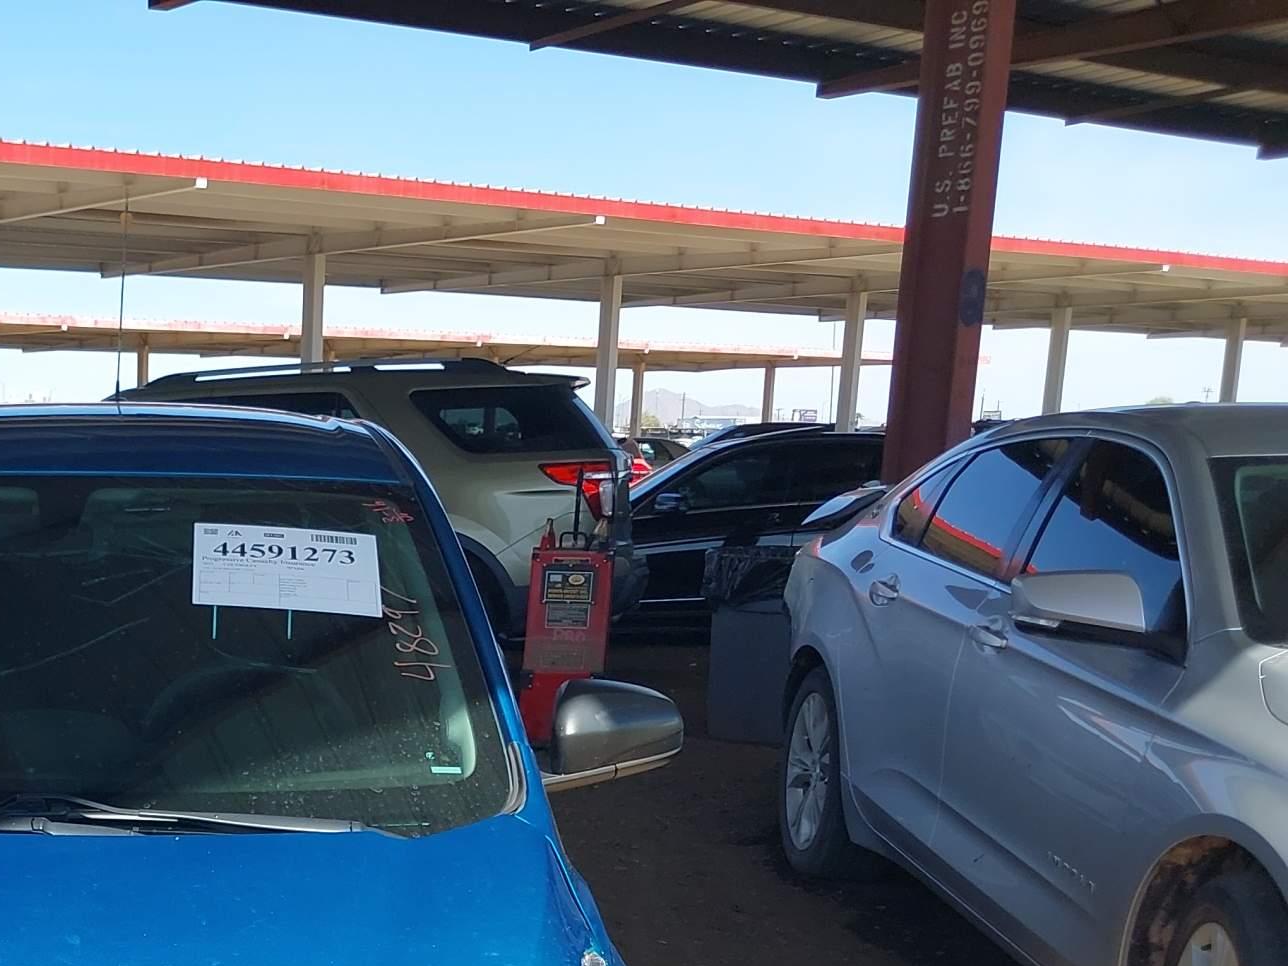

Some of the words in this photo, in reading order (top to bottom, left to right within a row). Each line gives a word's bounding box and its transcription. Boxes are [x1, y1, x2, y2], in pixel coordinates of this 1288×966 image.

[948, 10, 967, 49] INC
[938, 61, 963, 158] PREFAB
[932, 171, 953, 218] U.S.
[213, 541, 355, 565] 44591273
